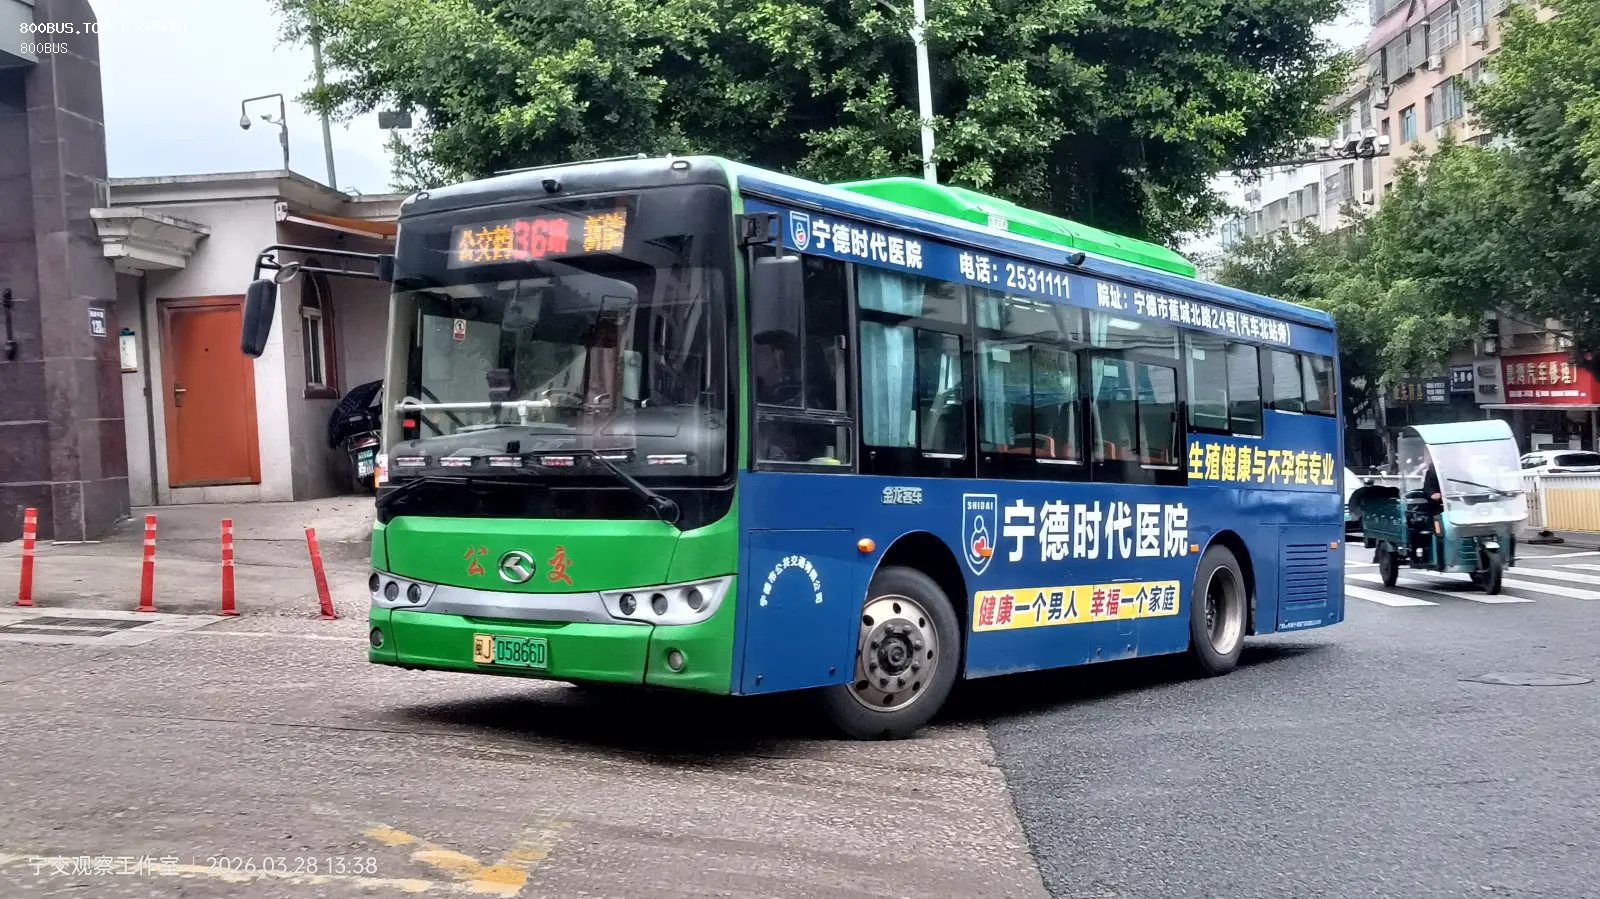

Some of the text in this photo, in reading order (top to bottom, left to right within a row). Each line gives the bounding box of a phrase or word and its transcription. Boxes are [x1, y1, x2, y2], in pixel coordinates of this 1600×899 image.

[812, 220, 922, 269] 宁德时代医院
[1188, 441, 1335, 486] 生殖健康与不孕症专业
[882, 486, 922, 504] 金龙客车
[967, 500, 993, 511] SHIDAI
[1003, 499, 1189, 562] 宁德时代医院
[464, 546, 488, 576] 公
[978, 586, 1176, 627] 健康一个男人 幸福一个家庭
